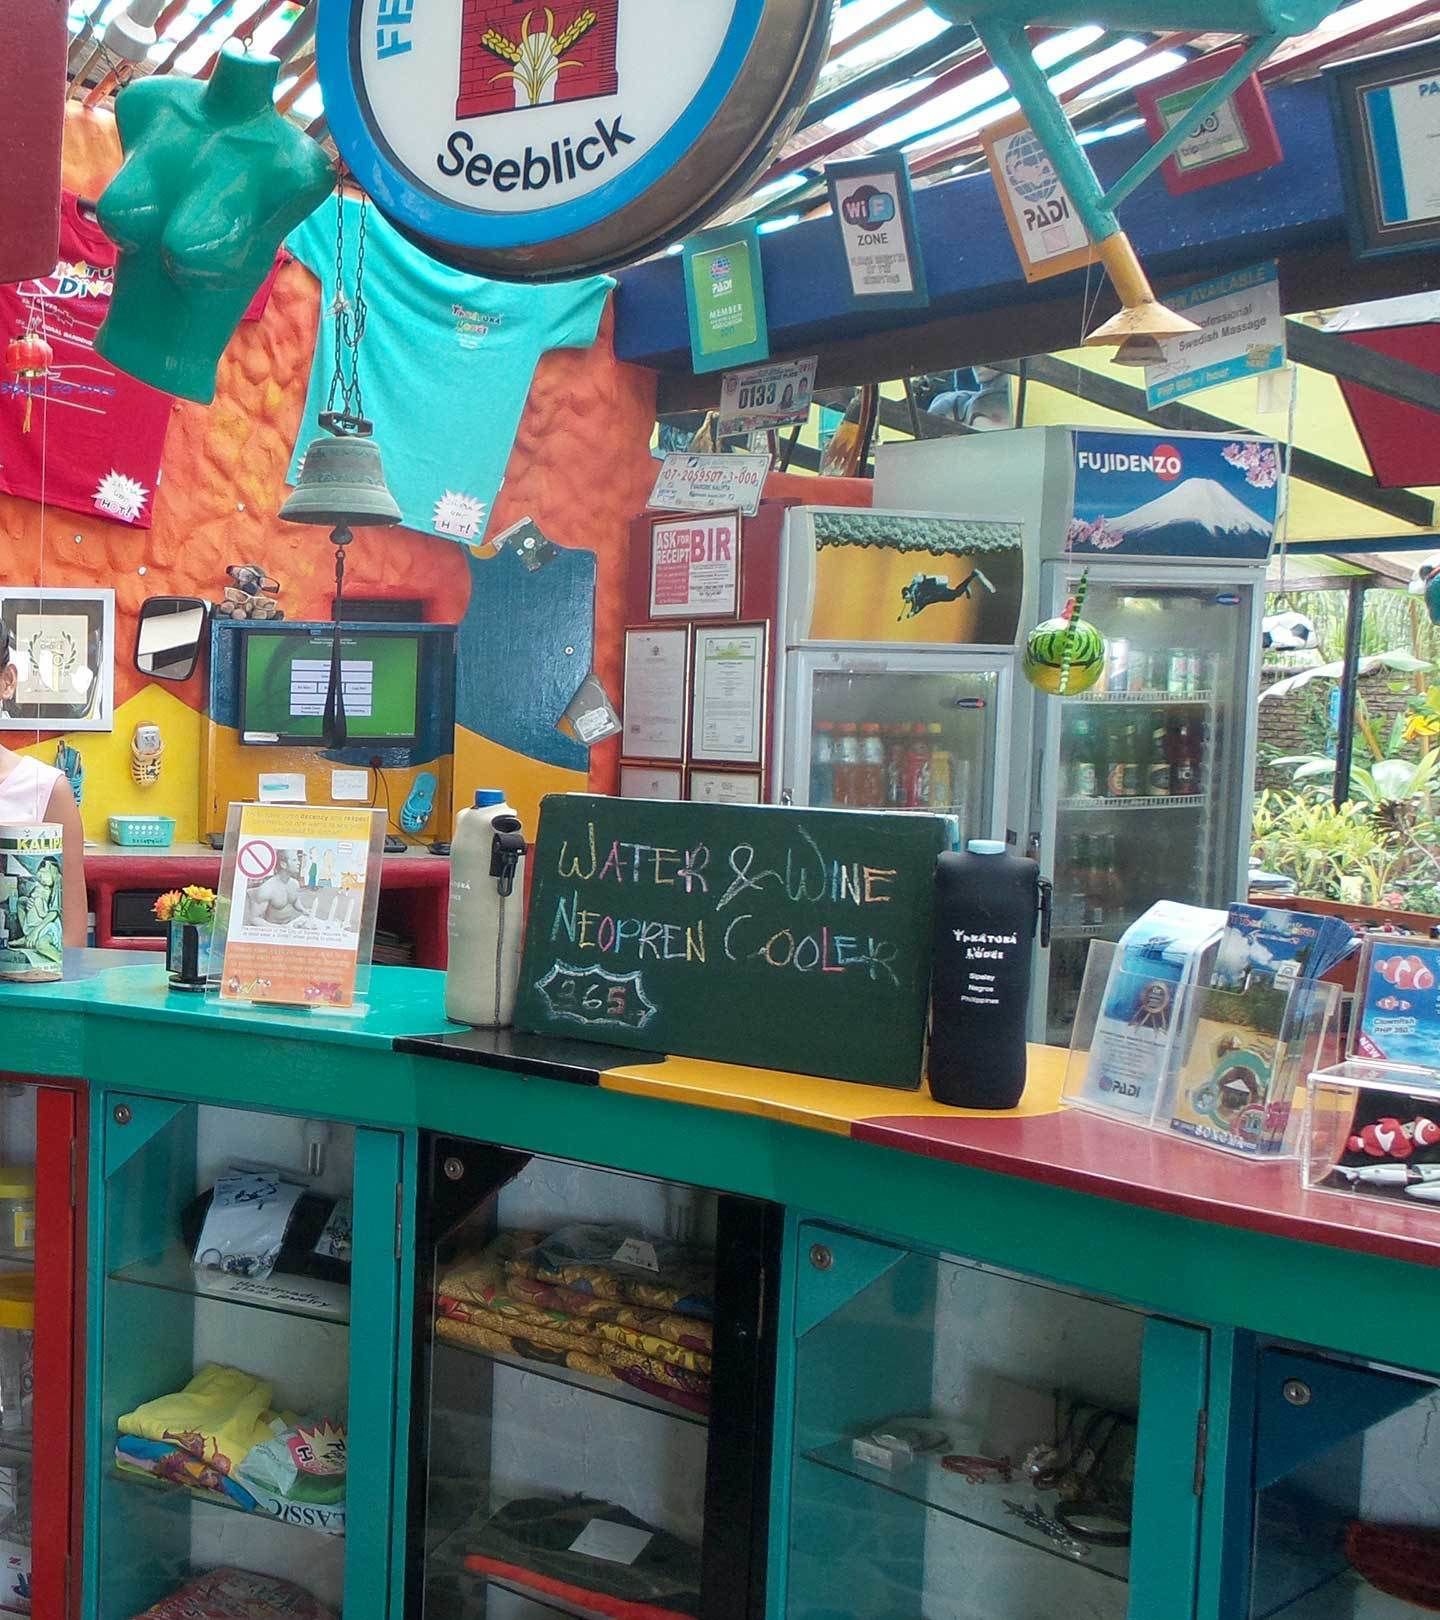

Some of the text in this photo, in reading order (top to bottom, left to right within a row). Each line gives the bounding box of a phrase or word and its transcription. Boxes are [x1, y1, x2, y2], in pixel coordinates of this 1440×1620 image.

[1419, 81, 1440, 96] PA
[436, 114, 636, 192] Seeblick
[1023, 197, 1069, 232] PADI
[857, 232, 889, 246] ZONE
[712, 280, 733, 294] PADI
[1200, 303, 1253, 328] ofessional
[1178, 316, 1267, 352] Swedish Massage
[1078, 451, 1182, 474] FUJIDENZO
[101, 499, 133, 517] HOT!
[441, 520, 471, 534] HT!
[657, 527, 731, 563] ASK FOR BIR
[657, 548, 690, 565] RECEIPT
[558, 823, 896, 912] WATER & WINE
[550, 890, 900, 987] NEOPREN COOLER
[1359, 1035, 1382, 1059] NEW
[1112, 1080, 1142, 1099] PADI
[268, 1498, 346, 1528] LASSIC
